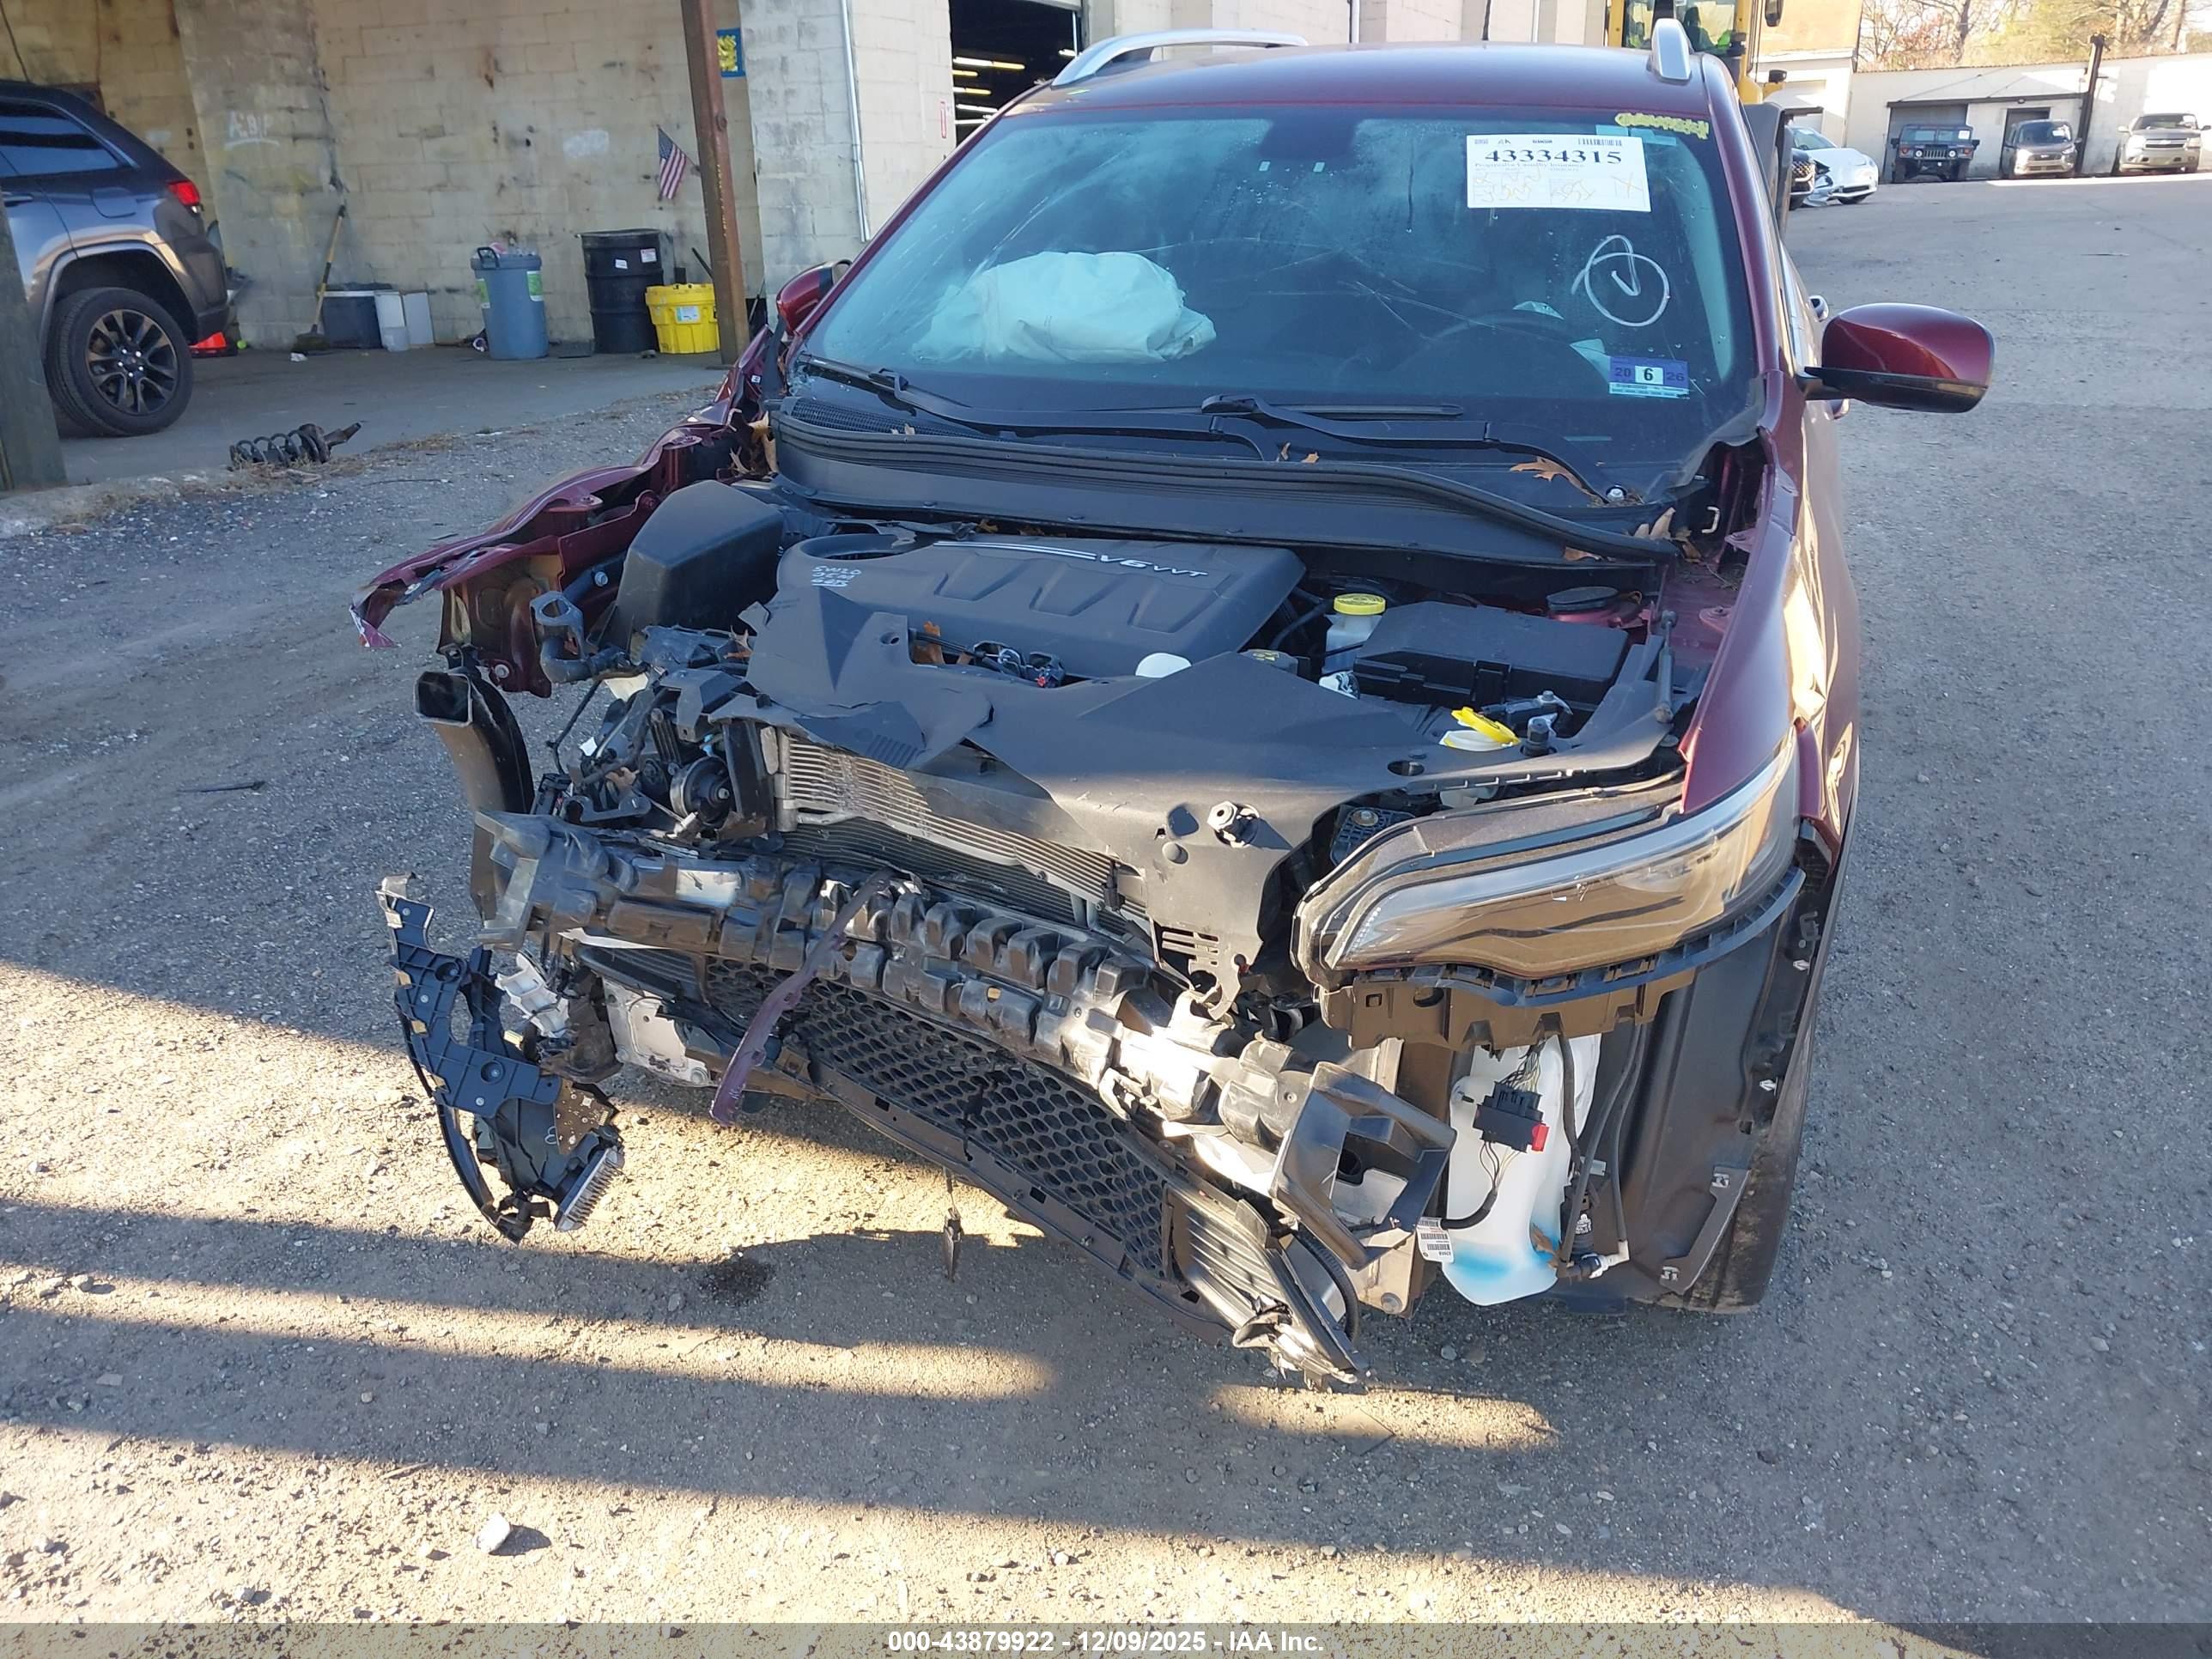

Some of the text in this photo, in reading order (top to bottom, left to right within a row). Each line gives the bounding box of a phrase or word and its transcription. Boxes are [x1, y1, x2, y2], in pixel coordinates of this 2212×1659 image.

[1485, 149, 1622, 164] 43334315
[1614, 368, 1685, 382] 20 6 26
[1100, 555, 1209, 577] V6 VVT
